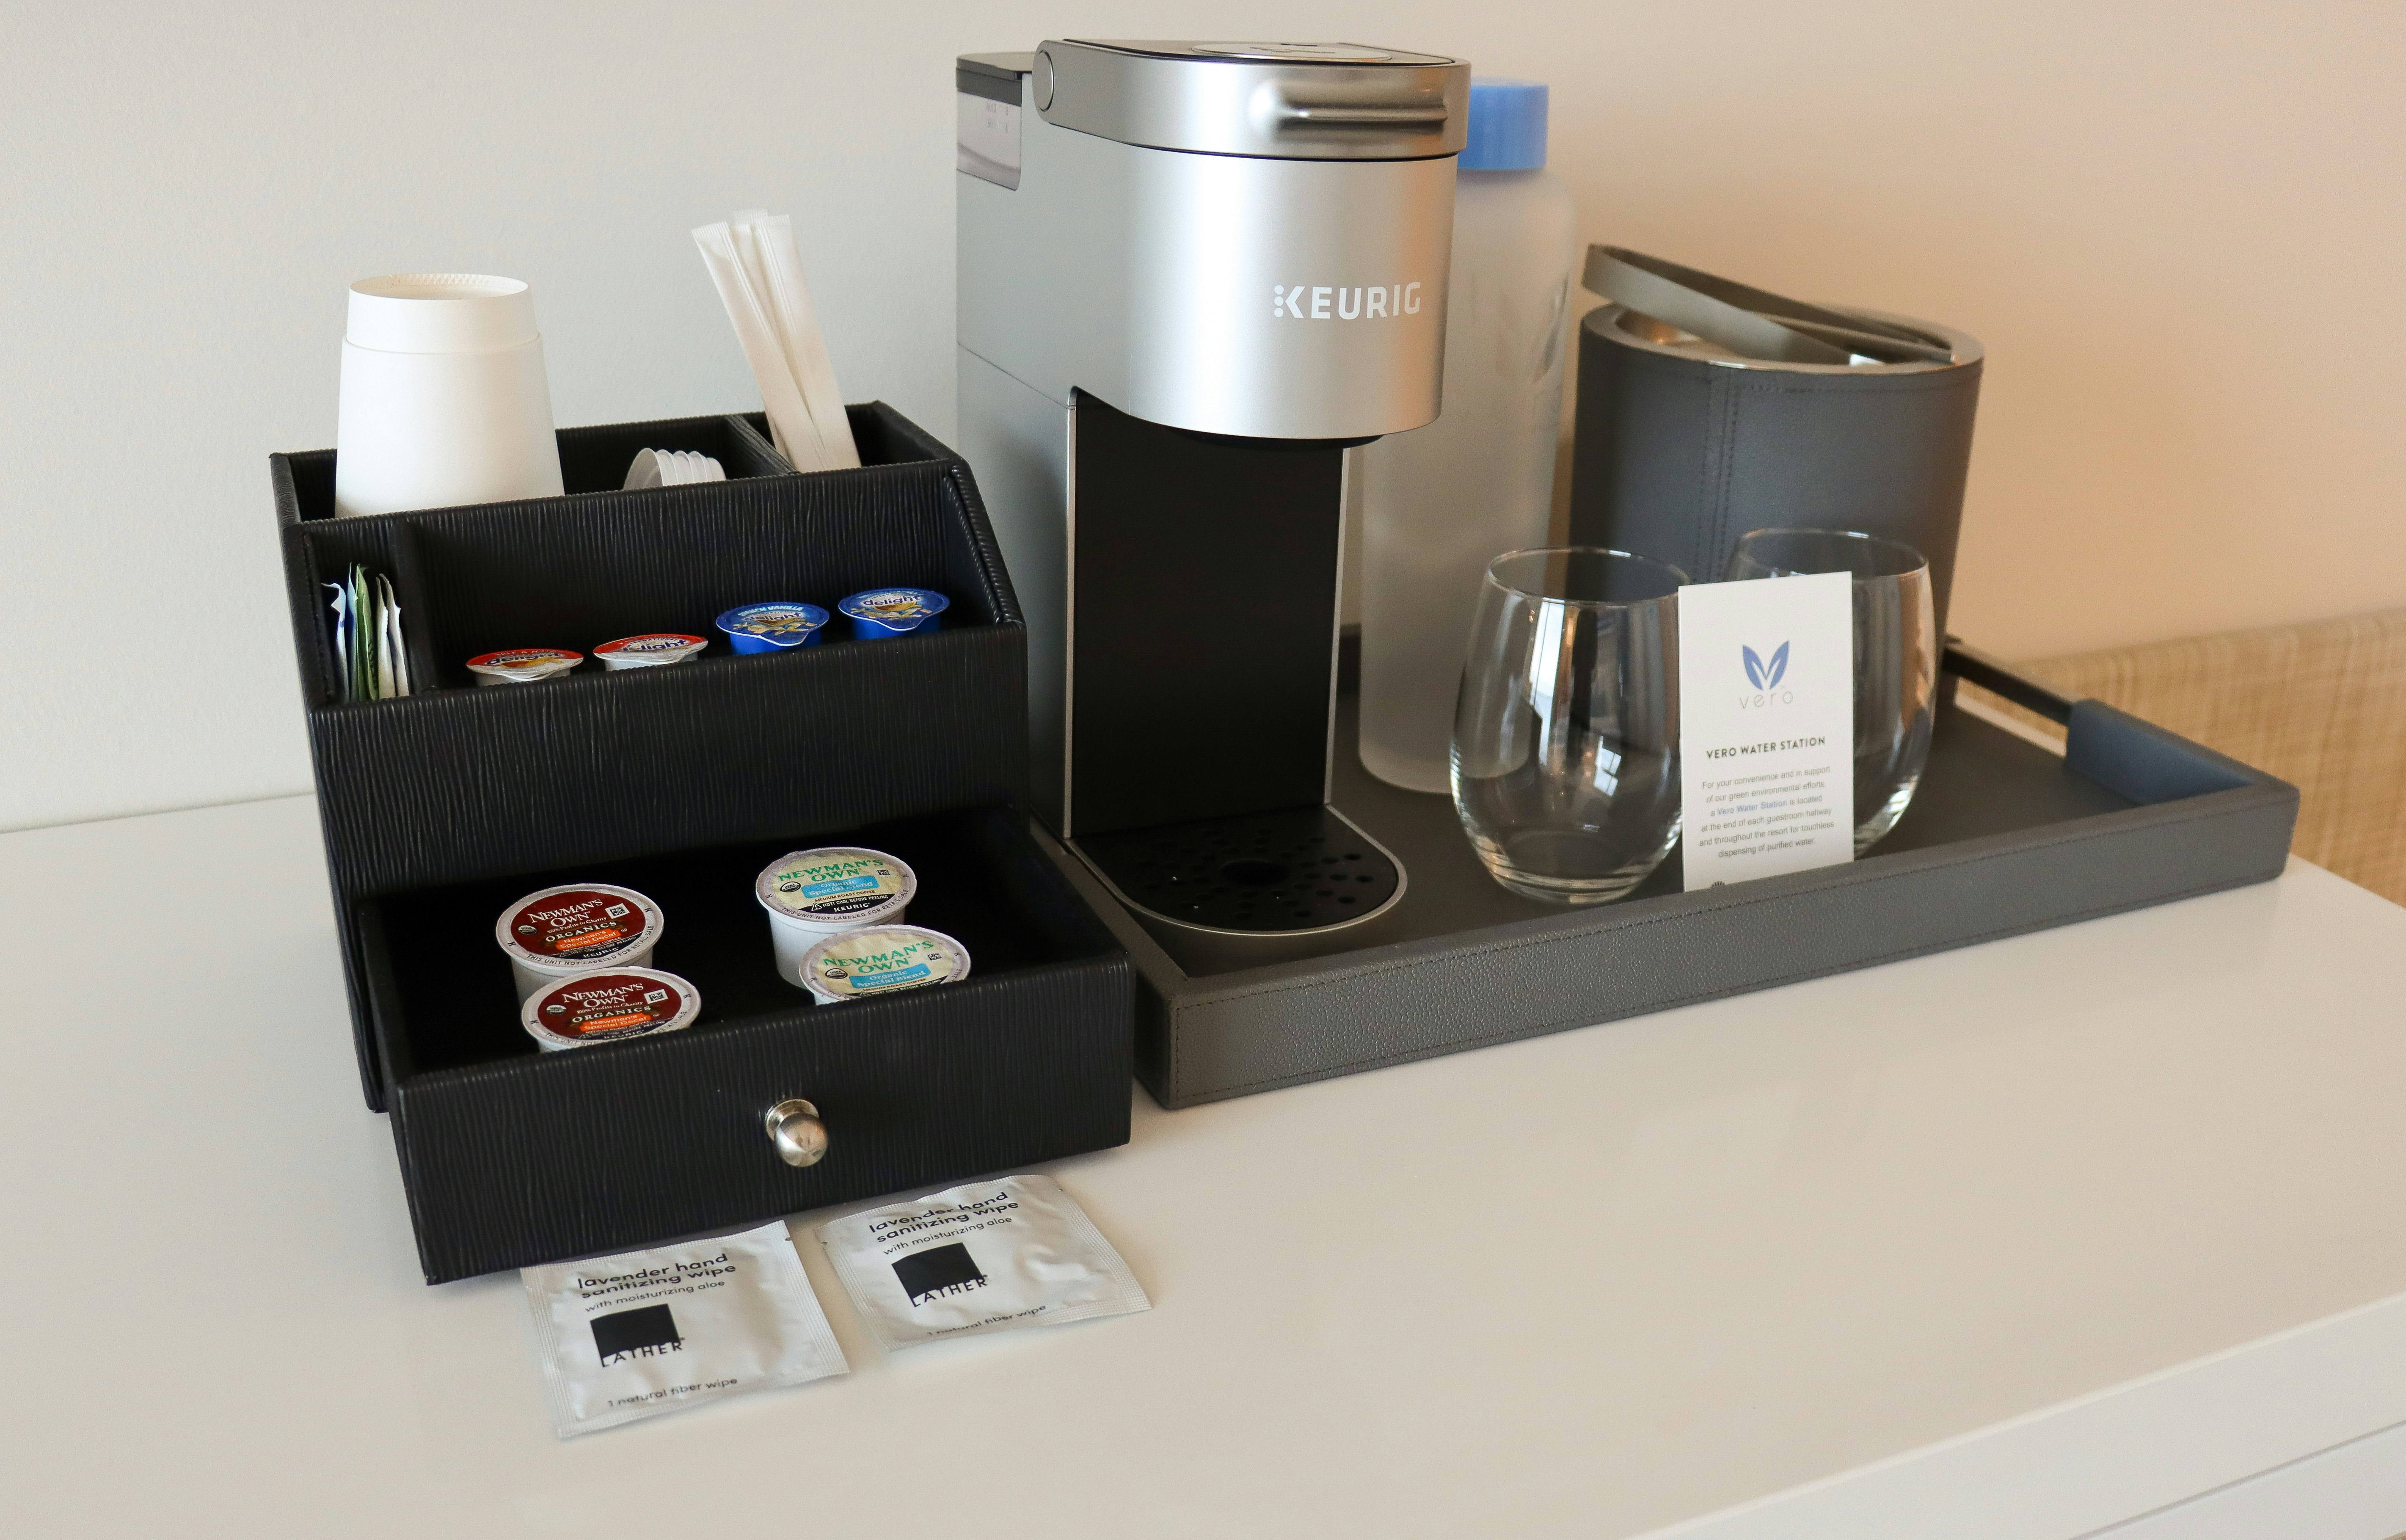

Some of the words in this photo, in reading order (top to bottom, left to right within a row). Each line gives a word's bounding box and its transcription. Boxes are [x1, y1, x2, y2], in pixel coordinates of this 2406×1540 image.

[1274, 282, 1421, 320] KEURIG
[863, 596, 920, 605] delight
[745, 612, 802, 621] delight
[1739, 691, 1794, 709] vero
[1706, 747, 1737, 759] VERO
[1741, 742, 1777, 755] WATER
[1781, 736, 1825, 750] STATION
[1717, 779, 1732, 789] your
[1735, 773, 1779, 785] convenience
[1781, 770, 1794, 779] and
[1804, 765, 1830, 776] support
[1707, 795, 1713, 803] of
[1729, 791, 1749, 802] green
[1752, 783, 1801, 797] environmental
[1737, 804, 1758, 813] Water
[1761, 800, 1788, 809] Station
[1797, 795, 1823, 804] located
[1724, 820, 1737, 829] end
[1748, 817, 1765, 825] each
[1767, 812, 1804, 824] guestroom
[1699, 837, 1712, 846] and
[1715, 833, 1753, 844] throughout
[1768, 826, 1788, 836] resort
[1801, 822, 1834, 831] touchless
[1719, 846, 1757, 858] dispensing
[1758, 844, 1766, 852] of
[1767, 840, 1793, 852] purified
[778, 859, 884, 882] NEWMAN'S
[811, 868, 860, 882] OWN
[808, 886, 844, 895] Special
[820, 879, 858, 888] Organic
[833, 903, 869, 912] KEURIG
[882, 898, 901, 910] RETAIL
[899, 889, 909, 899] SALE
[527, 898, 603, 923] NEWMAN'S
[550, 911, 590, 927] OWN
[545, 921, 617, 942] ORGANICS
[560, 922, 578, 931] Profits
[560, 940, 591, 948] Special
[592, 932, 616, 942] Decaf
[563, 931, 607, 943] Newman's
[583, 955, 616, 964] LABELED
[618, 948, 631, 957] FOR
[631, 935, 649, 949] RETAIL
[645, 925, 654, 936] SALE
[583, 948, 618, 958] KEURIG
[823, 941, 934, 966] NEWMAN'S
[858, 957, 909, 973] OWN
[857, 977, 895, 987] Special
[896, 971, 926, 980] Blend
[869, 970, 908, 980] Organic
[562, 983, 644, 1003] NEWMAN'S
[583, 995, 625, 1008] OWN
[572, 1006, 652, 1023] ORGANICS
[590, 1015, 638, 1025] Newman's
[869, 1209, 953, 1232] lavender
[958, 1192, 1008, 1211] hand
[877, 1214, 970, 1242] sanitizing
[973, 1202, 1019, 1214] wipe
[884, 1241, 909, 1255] with
[912, 1224, 984, 1245] moisturizing
[987, 1217, 1012, 1226] aloe
[578, 1267, 669, 1288] lavender
[676, 1253, 728, 1272] hand
[582, 1274, 682, 1298] sanitizing
[687, 1265, 736, 1277] wipe
[585, 1300, 612, 1312] with
[616, 1285, 694, 1304] moisturizing
[698, 1281, 725, 1290] aloe
[911, 1278, 988, 1307] LATHER
[985, 1314, 1013, 1324] fiber
[1017, 1305, 1046, 1317] wipe
[602, 1341, 682, 1367] LATHER
[618, 1389, 667, 1405] natural
[671, 1383, 702, 1394] fiber
[706, 1378, 738, 1389] wipe
